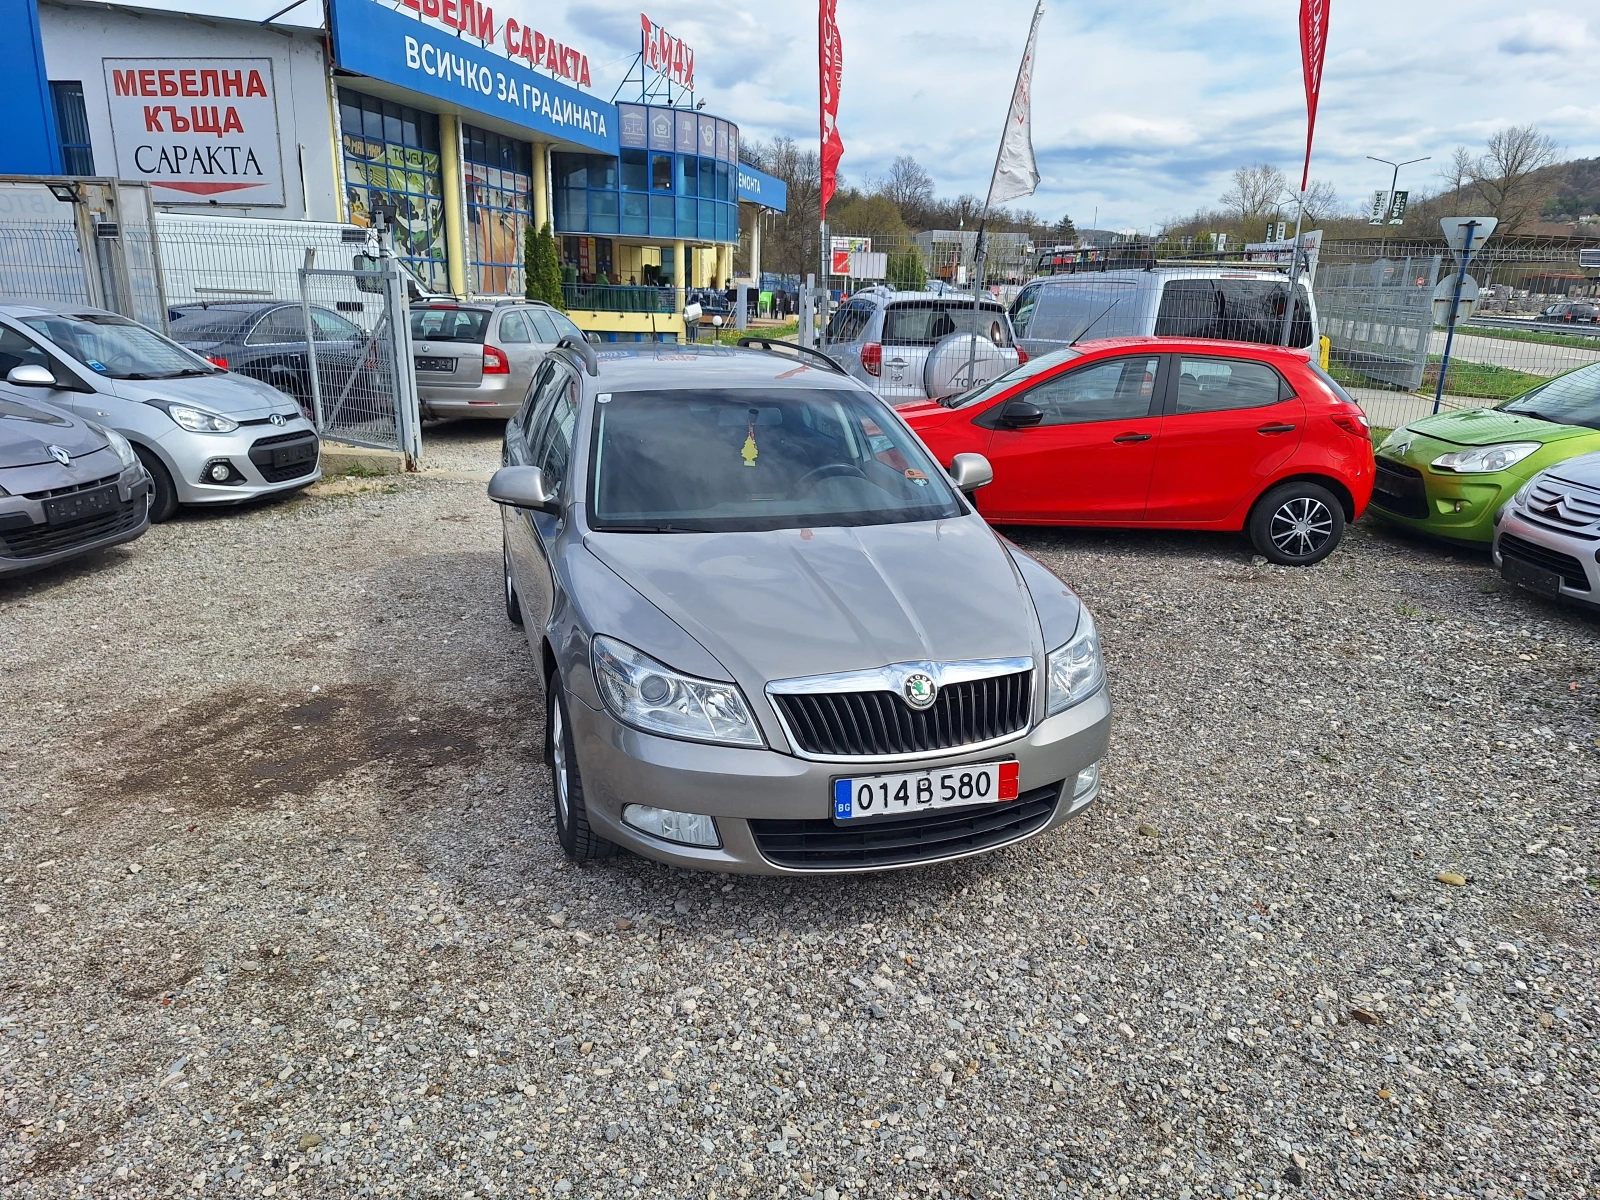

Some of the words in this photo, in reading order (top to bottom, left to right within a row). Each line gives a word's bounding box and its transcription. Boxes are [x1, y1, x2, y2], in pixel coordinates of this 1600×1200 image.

[504, 17, 592, 88] САРАКТА
[112, 69, 268, 98] МЕБЕЛНА
[404, 35, 493, 96] ВСИЧКО
[496, 72, 520, 106] ЗА
[522, 83, 607, 138] ГРАДИНАТА
[143, 105, 245, 139] КЪЩА
[134, 145, 264, 175] САРАКТА
[738, 172, 761, 195] ЕМОНТА
[1373, 192, 1382, 216] efbet
[1392, 192, 1403, 217] efbet
[954, 378, 991, 388] TOYO
[838, 803, 851, 813] BG
